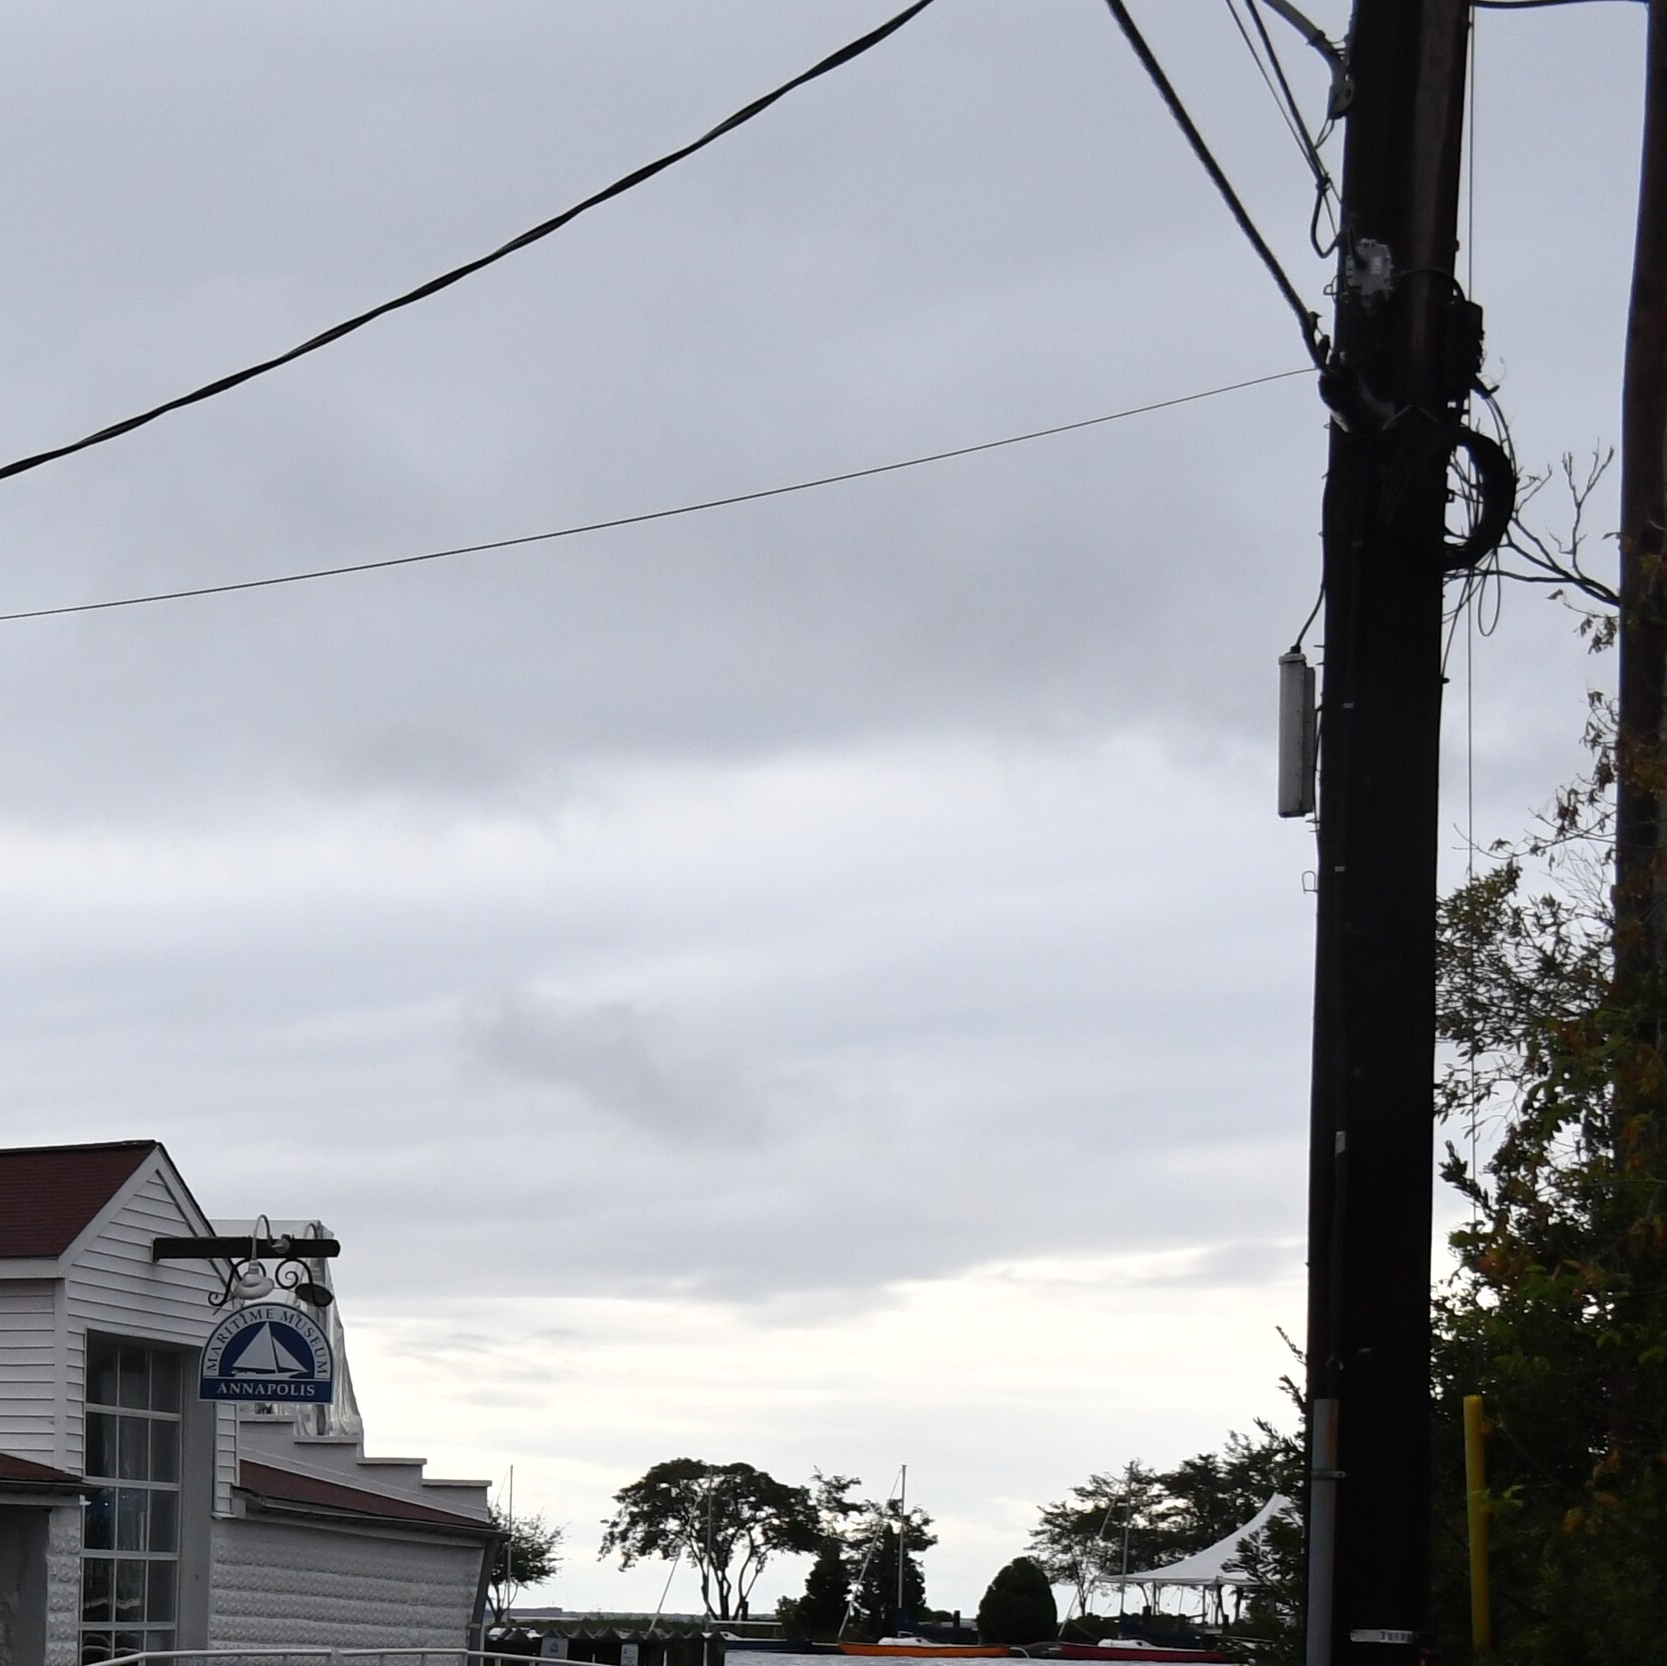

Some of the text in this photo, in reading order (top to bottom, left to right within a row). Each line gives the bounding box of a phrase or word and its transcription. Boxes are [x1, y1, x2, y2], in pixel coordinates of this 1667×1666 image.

[206, 1308, 328, 1374] MARITIME MUSEUM
[217, 1382, 315, 1397] ANNAPOLIS
